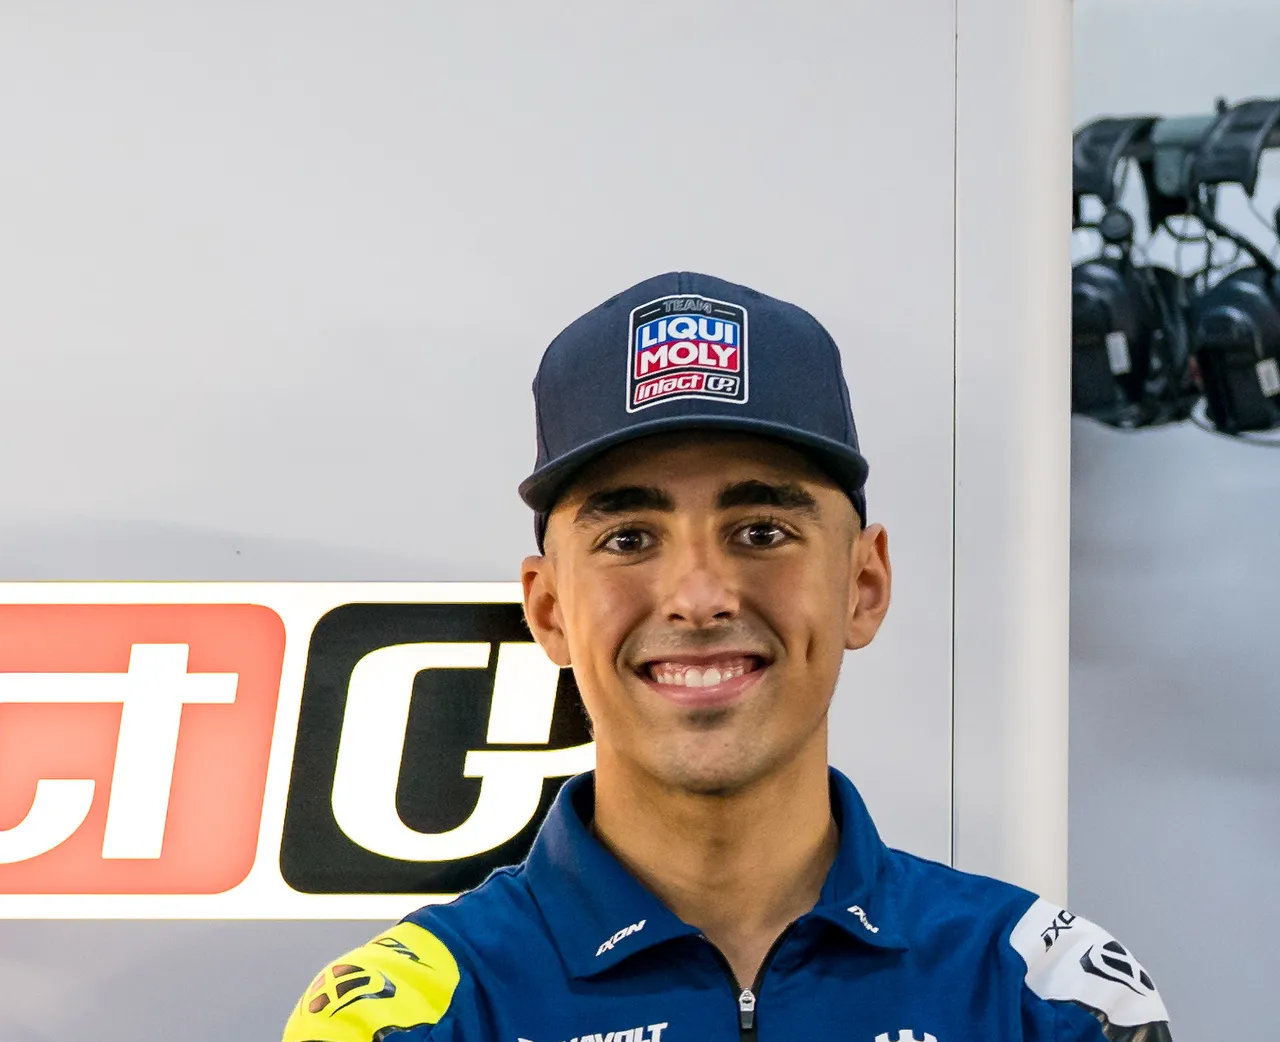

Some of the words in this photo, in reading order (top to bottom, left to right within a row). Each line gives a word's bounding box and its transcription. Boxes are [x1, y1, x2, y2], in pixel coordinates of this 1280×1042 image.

[663, 298, 712, 314] TEAM
[641, 316, 734, 347] LIQUI
[640, 343, 737, 373] MOLY
